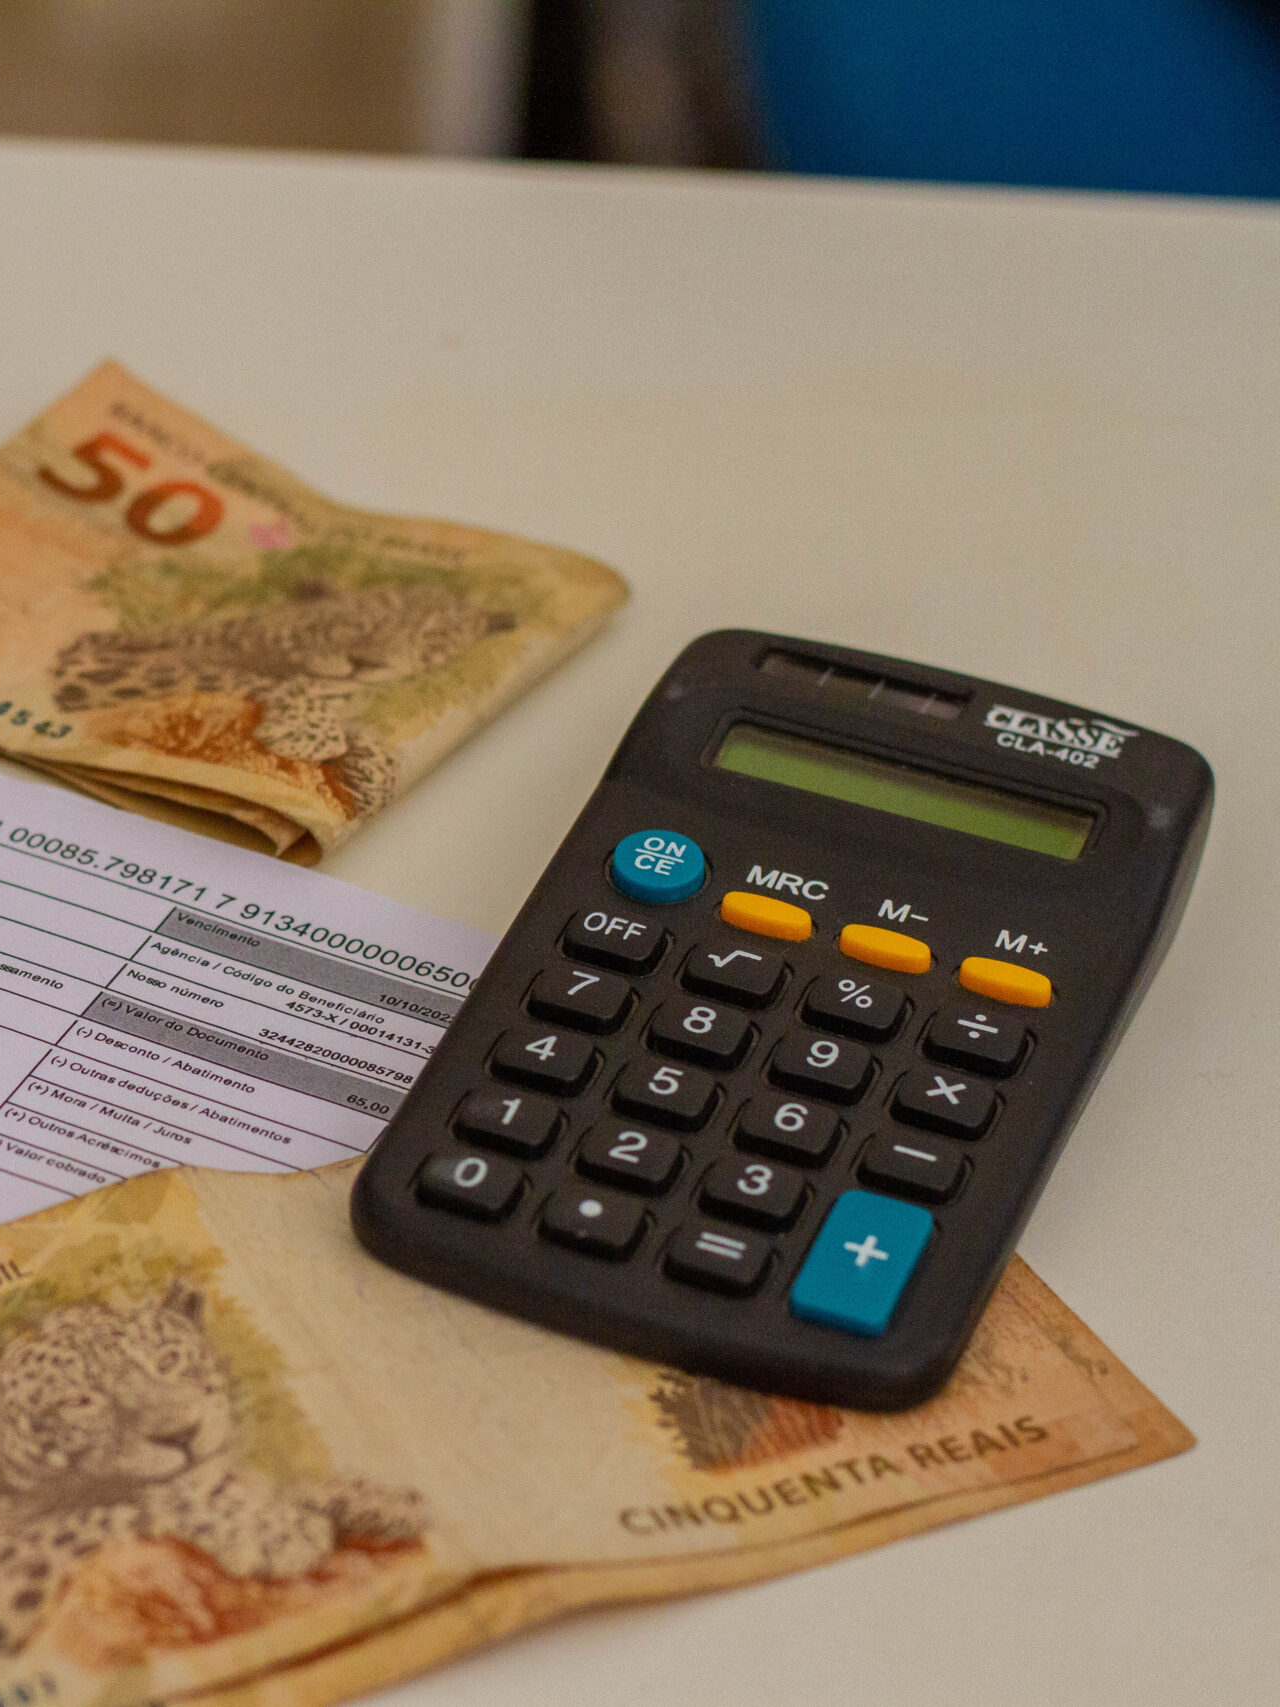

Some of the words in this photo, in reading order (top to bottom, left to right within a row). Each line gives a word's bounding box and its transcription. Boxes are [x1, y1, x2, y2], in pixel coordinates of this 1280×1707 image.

[35, 432, 227, 547] 50
[996, 732, 1100, 770] CLA-402
[643, 836, 687, 858] ON
[9, 827, 208, 902] 00085.798171
[214, 893, 237, 910] 7
[634, 854, 675, 877] CE
[583, 911, 647, 942] OFF
[745, 864, 830, 901] MRC
[995, 929, 1049, 957] M+
[176, 911, 261, 948] Vencimento
[126, 969, 167, 990] Nosso
[170, 983, 224, 1010] número
[151, 940, 210, 970] Agência
[222, 965, 273, 992] Código
[276, 979, 295, 996] do
[298, 989, 385, 1026] Beneficiário
[566, 970, 601, 997] 7
[837, 978, 873, 1010] %
[286, 1001, 336, 1024] 4573-X
[682, 1005, 717, 1034] 8
[124, 1005, 163, 1028] Valor
[164, 1018, 184, 1032] do
[186, 1026, 269, 1061] Documento
[525, 1035, 557, 1061] 4
[94, 1030, 160, 1062] Desconto
[172, 1059, 255, 1094] Abatimento
[806, 1039, 839, 1069] 9
[647, 1067, 684, 1096] 5
[51, 1087, 87, 1110] Mora
[99, 1105, 141, 1128] Multa
[153, 1123, 192, 1146] Juros
[69, 1061, 117, 1087] Outras
[117, 1077, 189, 1112] deduções
[199, 1105, 291, 1145] Abatimentos
[346, 1094, 390, 1115] 65,00
[500, 1098, 523, 1126] 1
[774, 1103, 809, 1132] 6
[28, 1114, 76, 1138] Outros
[78, 1132, 160, 1170] Acréscimos
[608, 1131, 649, 1163] 2
[5, 1140, 44, 1163] Valor
[47, 1155, 106, 1184] cobrado
[452, 1157, 488, 1188] 0
[737, 1163, 773, 1195] 3
[620, 1449, 903, 1537] CINQUENTA
[905, 1414, 1050, 1471] REAIS
